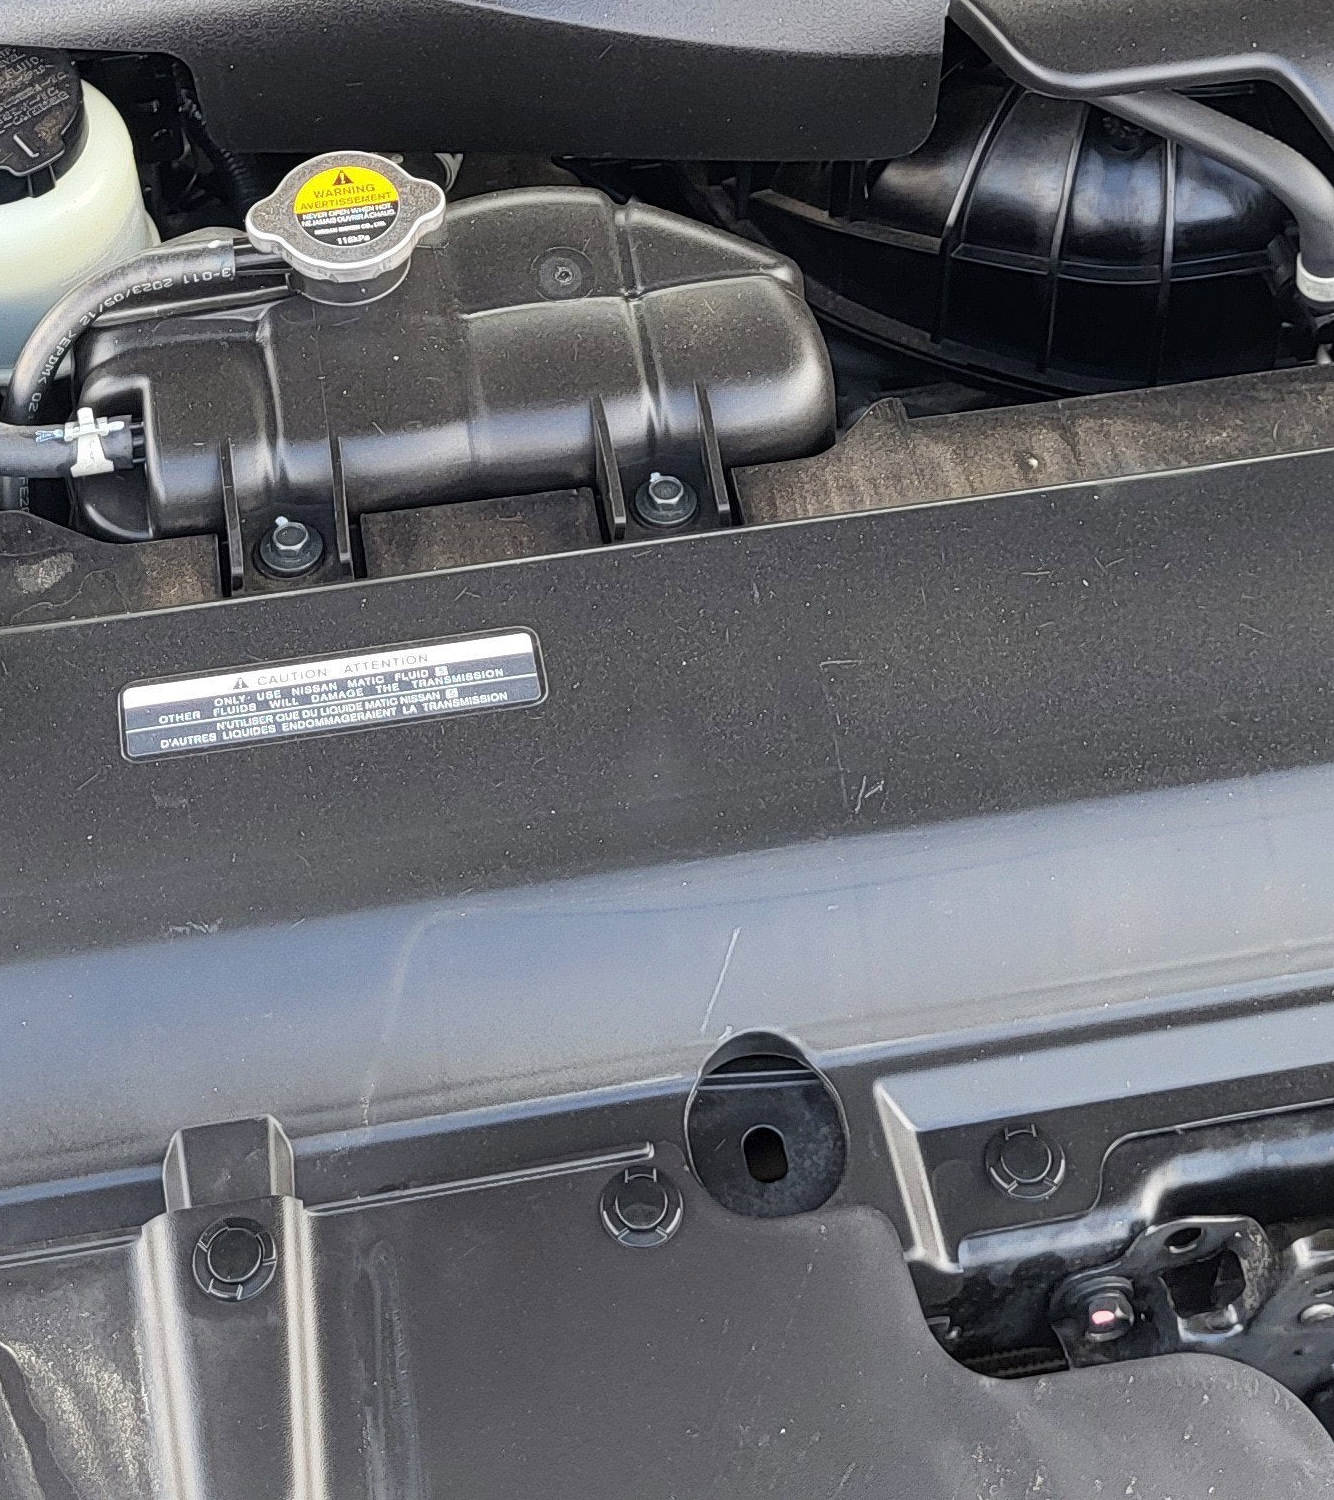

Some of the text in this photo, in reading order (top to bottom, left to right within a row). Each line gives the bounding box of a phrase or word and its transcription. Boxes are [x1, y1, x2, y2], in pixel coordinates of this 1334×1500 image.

[300, 191, 392, 210] AVERTISSEMENT
[313, 184, 376, 199] WARNING
[79, 277, 174, 326] 2023/05/12
[214, 694, 246, 707] ONLY
[256, 690, 281, 701] USE
[292, 682, 337, 696] NISSAN
[347, 675, 384, 688] MATIC
[395, 669, 429, 682] FLUID
[258, 654, 428, 685] CAUTION ATTENTION
[158, 668, 504, 724] OTHER FLUIDS WILL DAMAGE THE TRANSMISSION
[217, 714, 274, 731] N'UTILISER
[275, 711, 300, 722] QUE
[302, 708, 318, 717] DU
[320, 702, 363, 716] LIQUIDE
[365, 698, 398, 710] MATIC
[399, 691, 441, 706] NISSAN
[160, 691, 508, 749] D'AUTRES LIQUIDES ENDOMMAGERAIENT LA TRANSMISSION
